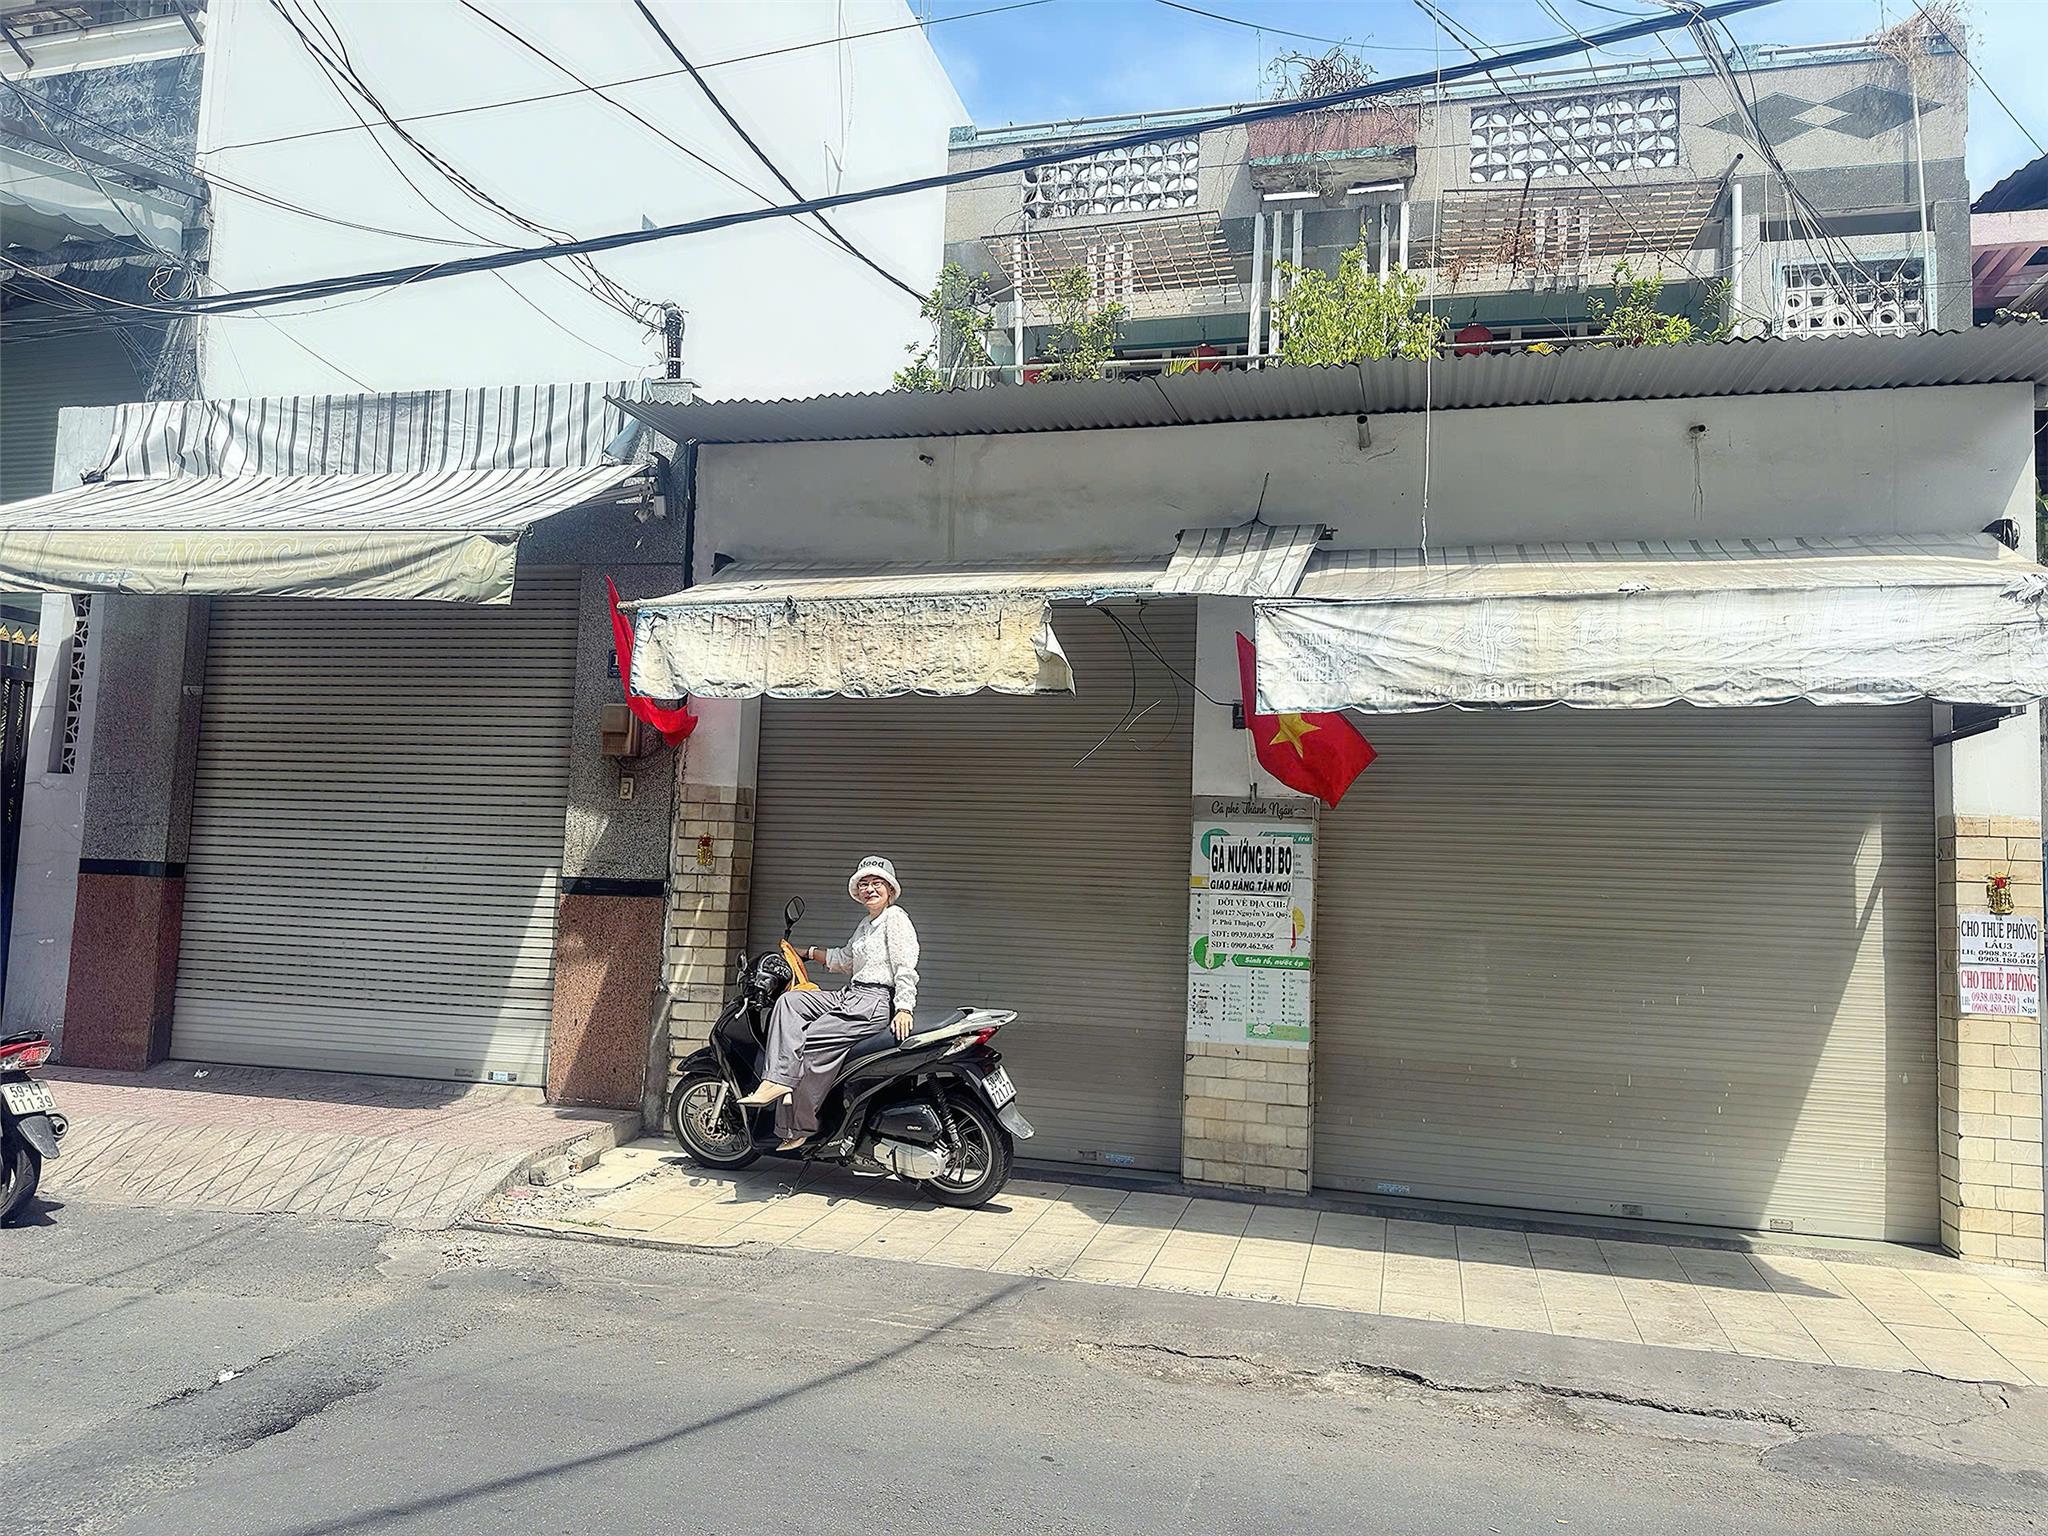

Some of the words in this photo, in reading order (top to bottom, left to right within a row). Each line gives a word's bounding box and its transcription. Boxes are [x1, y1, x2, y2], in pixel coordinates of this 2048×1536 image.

[1211, 837, 1225, 873] GÀ
[1227, 837, 1263, 874] NƯỚNG
[1265, 838, 1275, 874] BÍ
[1278, 846, 1292, 875] BO
[1210, 880, 1231, 890] GIAO
[1231, 878, 1255, 891] HÀNG
[1256, 878, 1274, 894] TẬN
[1961, 920, 1979, 937] CHO
[1981, 917, 2004, 938] THUÊ
[2007, 918, 2037, 940] PHÒNG
[1961, 970, 1979, 989] CHO
[1980, 967, 2005, 991] THUÊ
[2006, 967, 2037, 993] PHÒNG
[11, 1095, 54, 1112] 111.39
